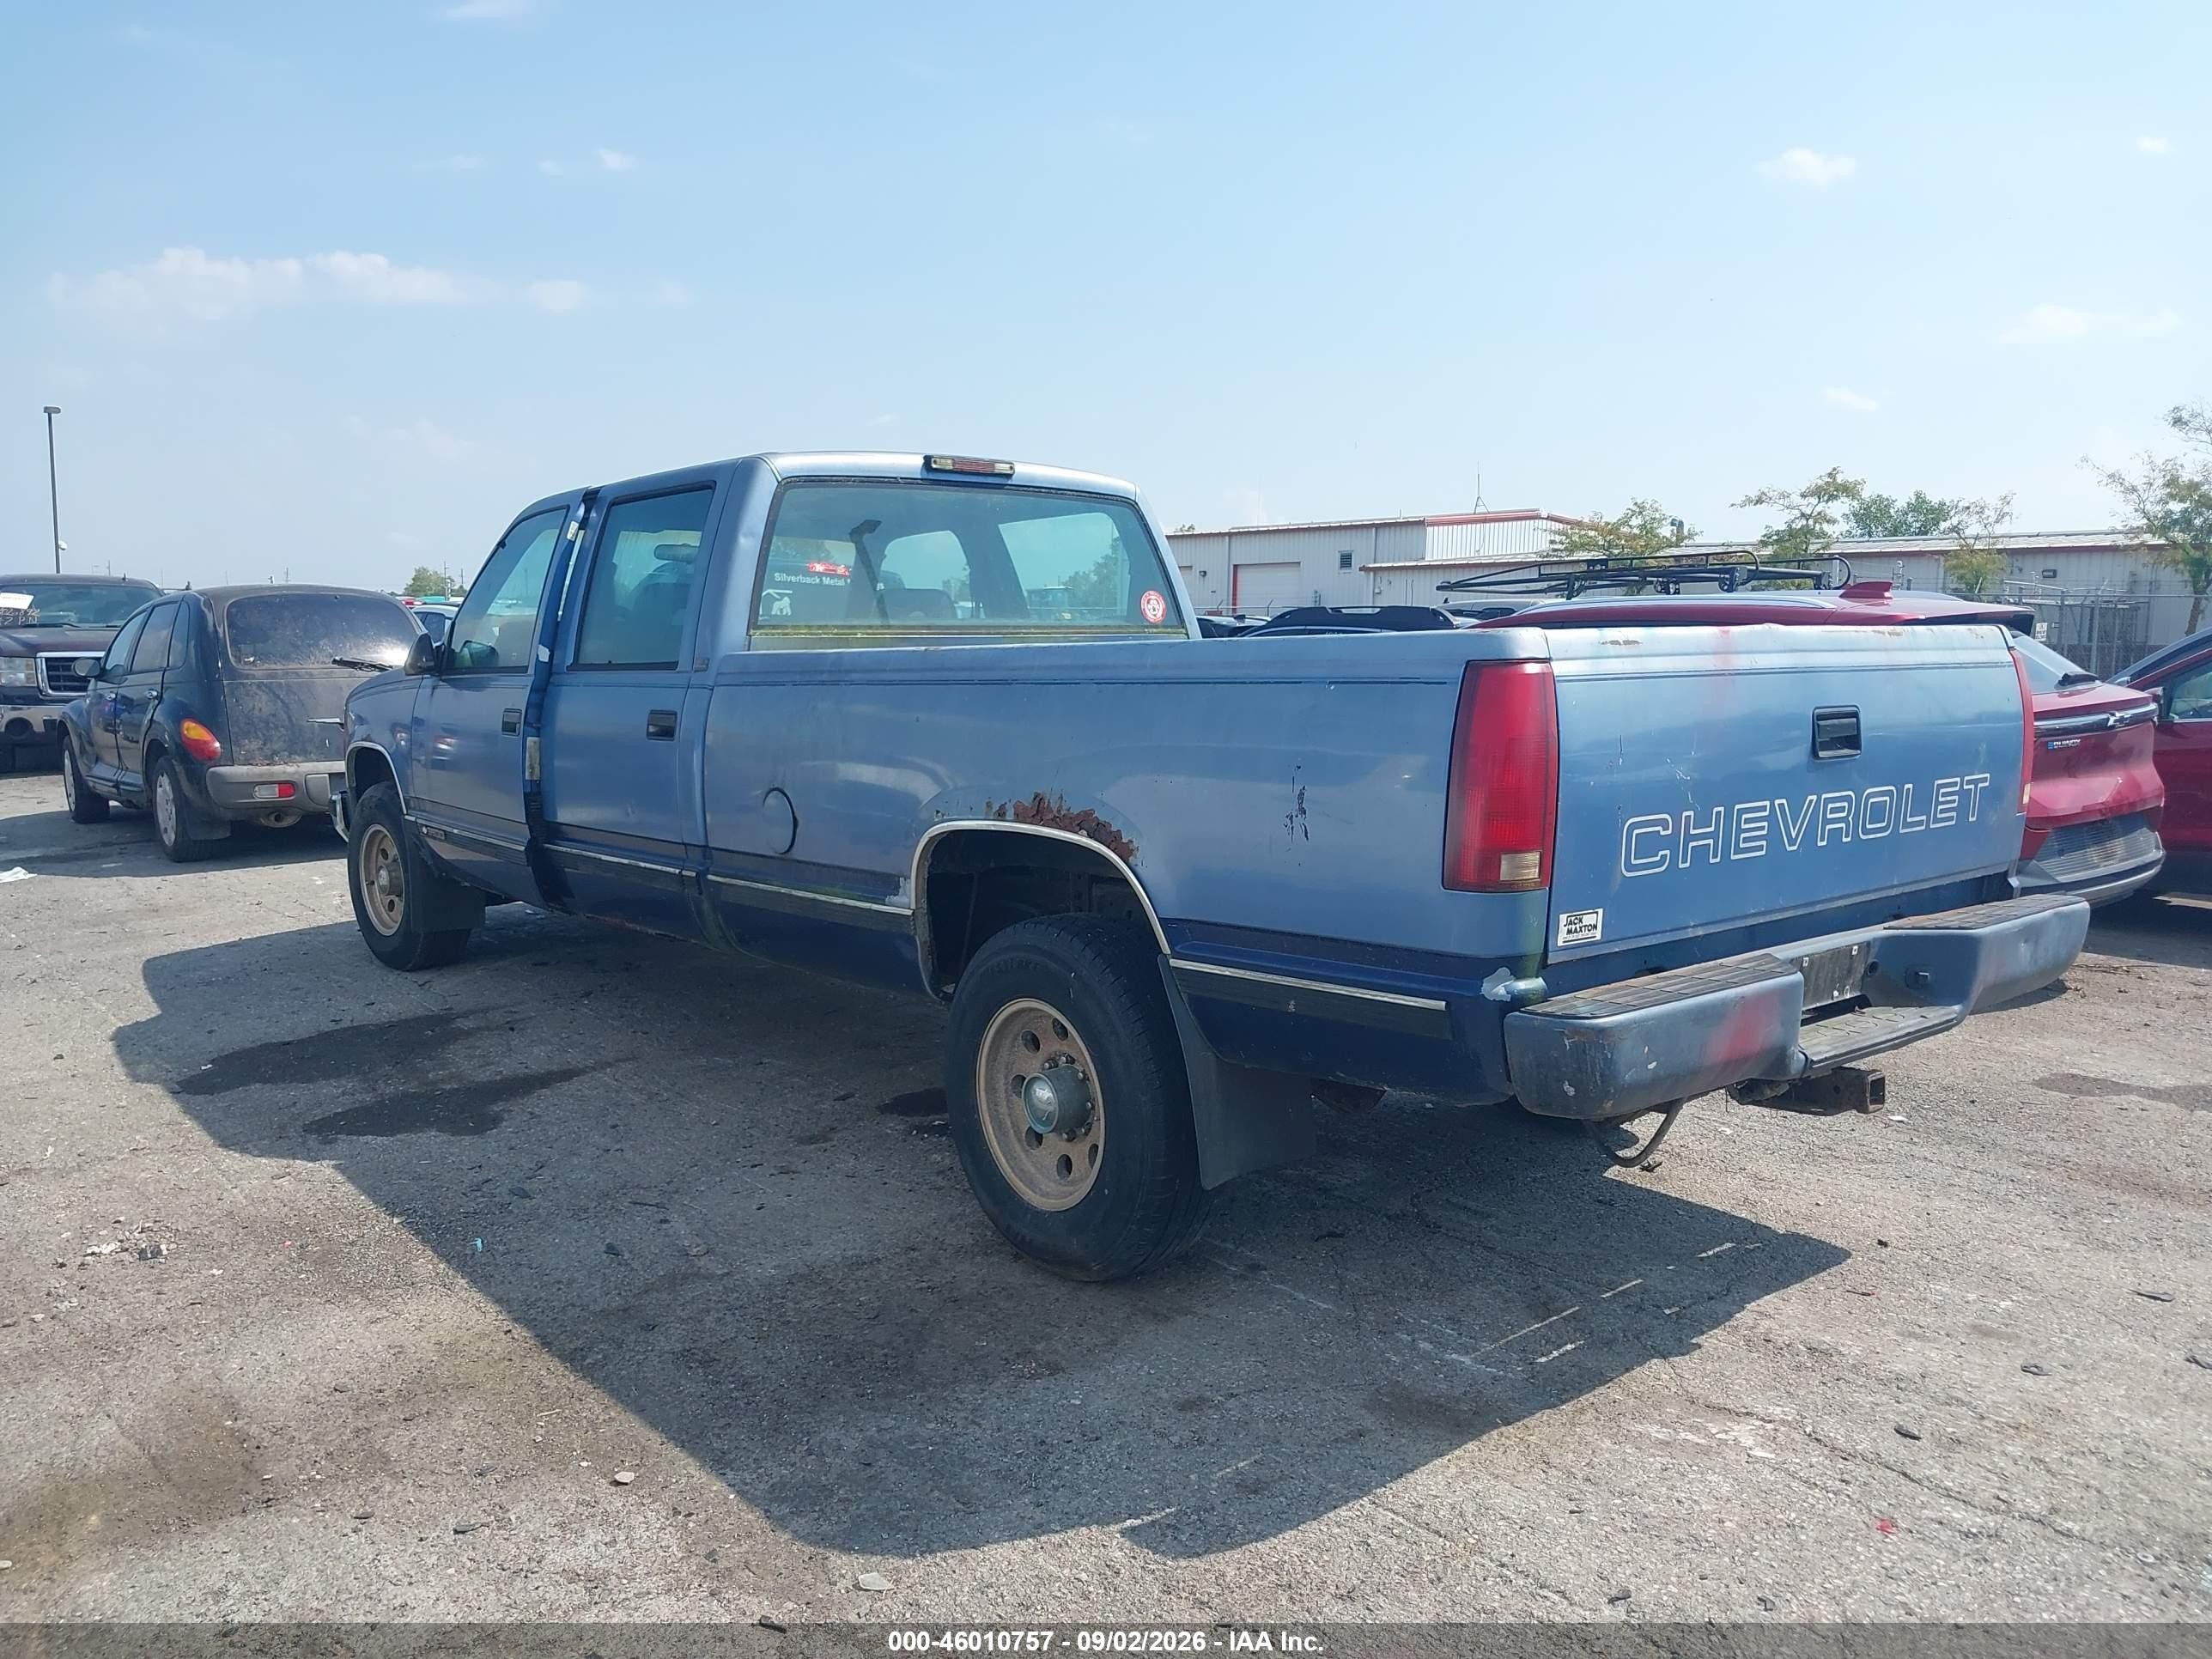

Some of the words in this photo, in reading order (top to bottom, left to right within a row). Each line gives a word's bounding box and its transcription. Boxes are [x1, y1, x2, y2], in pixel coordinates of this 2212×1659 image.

[775, 572, 821, 585] Silverback
[823, 576, 846, 586] Metal
[2047, 738, 2081, 749] EQUINOX
[1621, 774, 1990, 878] CHEVROLET
[1564, 915, 1583, 927] JACK
[1566, 923, 1597, 936] MAXTON
